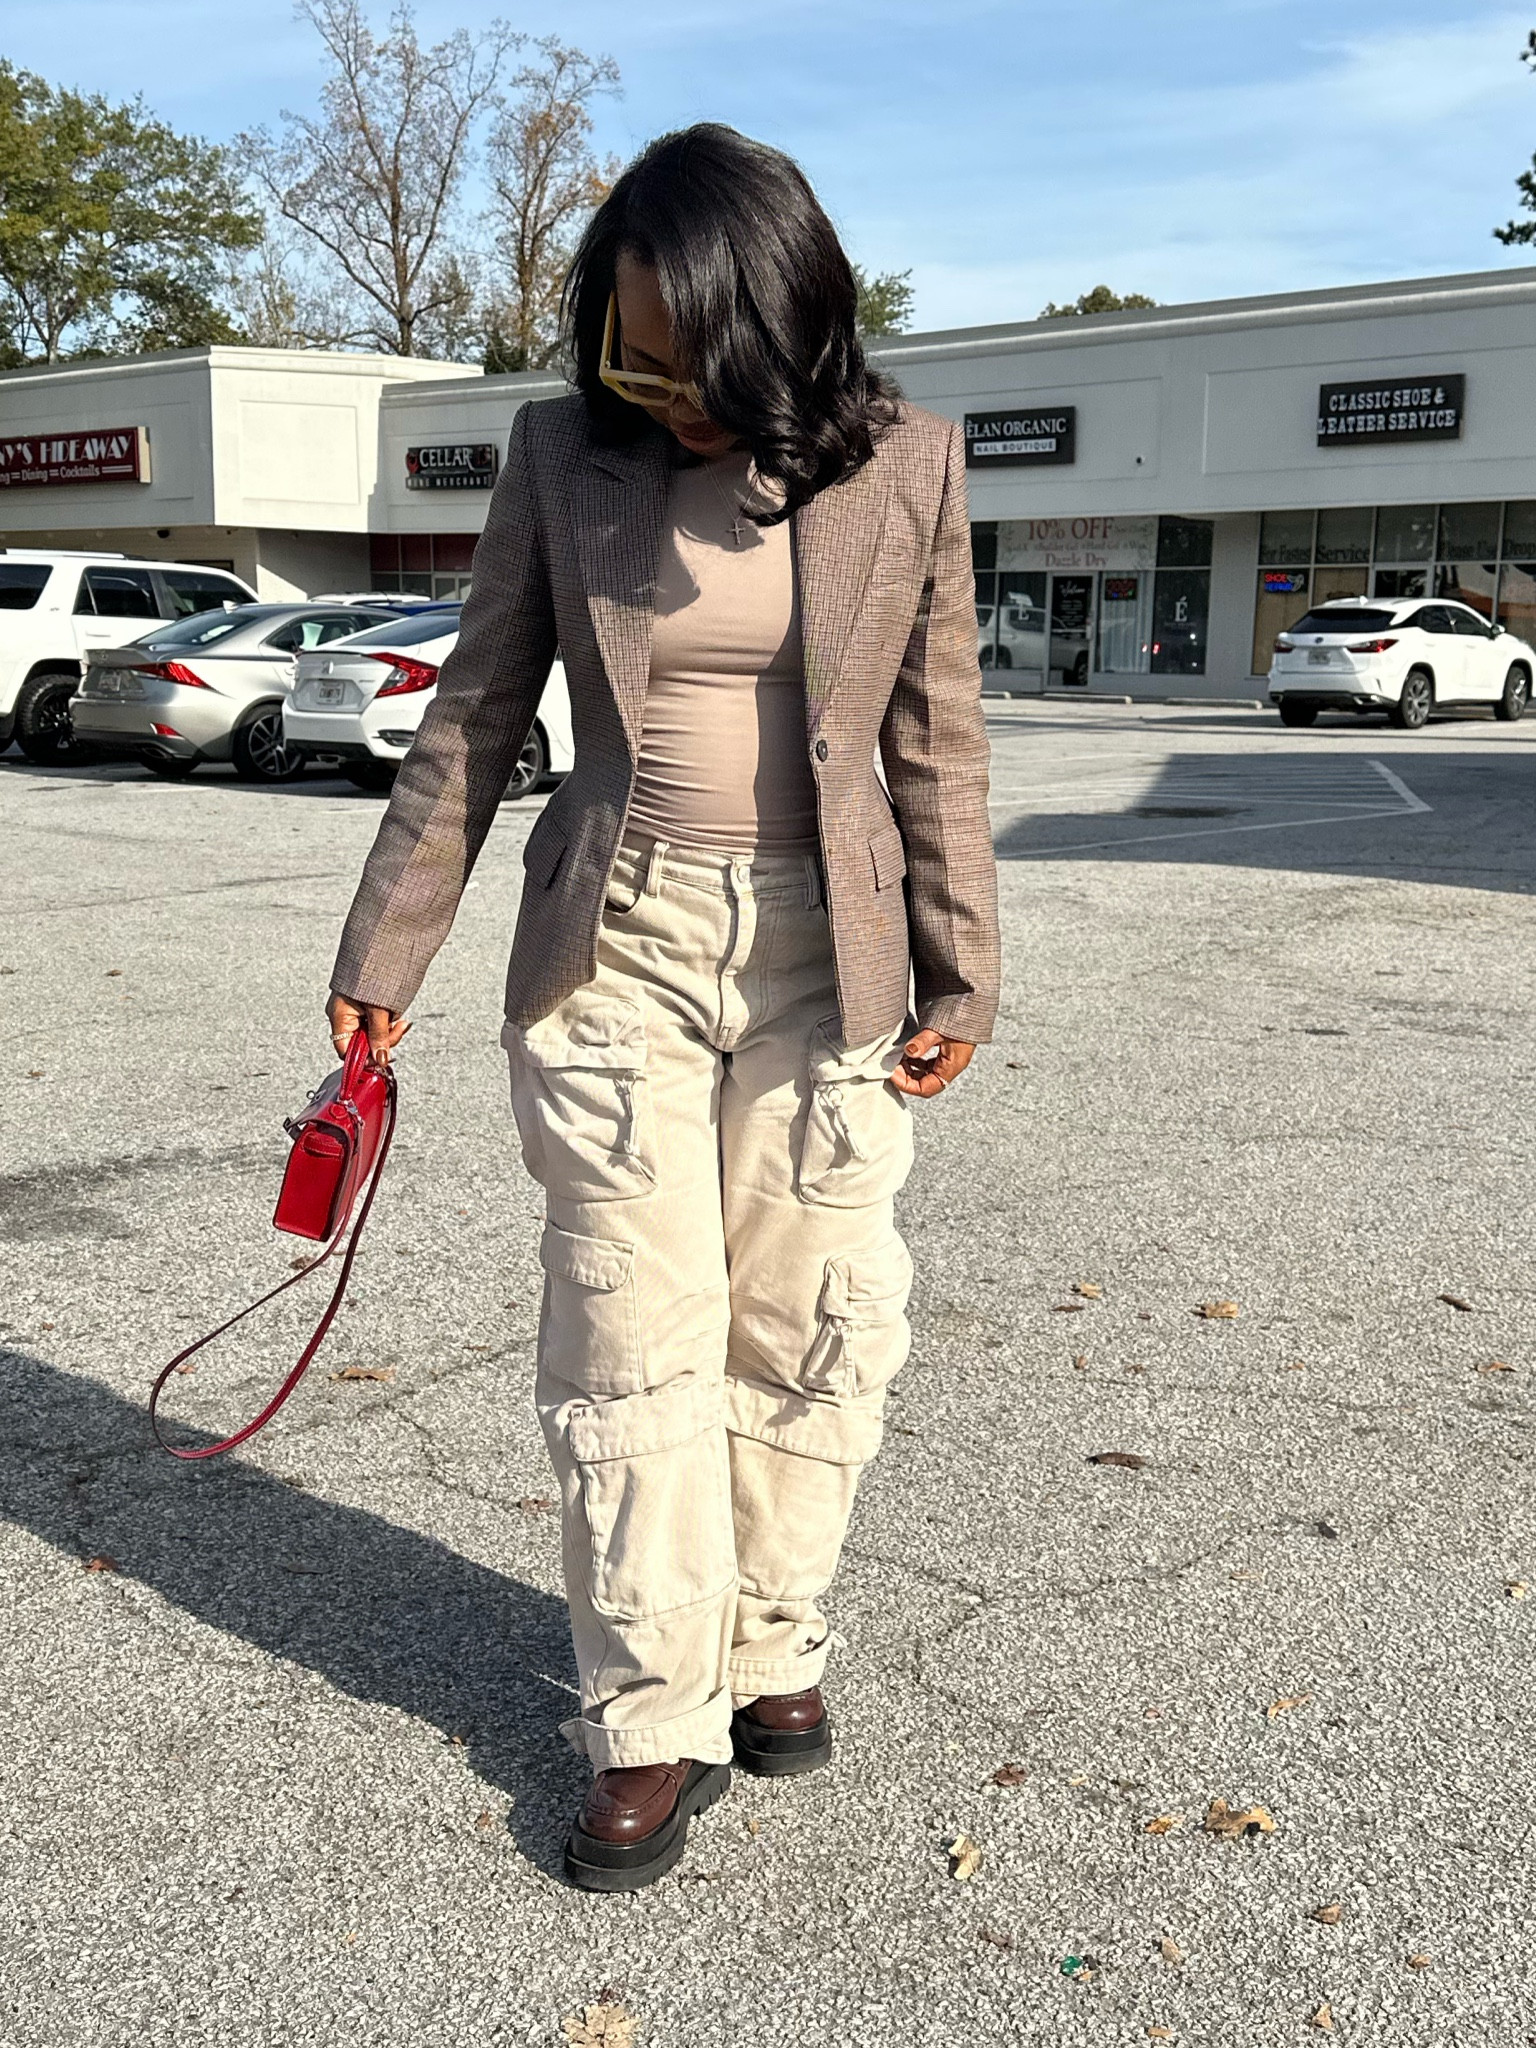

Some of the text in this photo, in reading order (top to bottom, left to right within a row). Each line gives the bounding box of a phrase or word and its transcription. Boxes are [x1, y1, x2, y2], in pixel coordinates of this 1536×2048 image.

[1328, 386, 1446, 411] CLASSIC SHOE &
[1003, 417, 1067, 436] ORGANIC
[1317, 409, 1457, 435] LEATHER SERVICE
[40, 435, 132, 464] HIDEAWAY
[419, 447, 475, 470] CELLAR
[976, 441, 1054, 453] NAIL BOUTIQUE
[21, 467, 48, 483] Dining
[60, 463, 101, 479] Cocktails
[1028, 519, 1066, 540] 10%
[1071, 517, 1114, 540] OFF
[1264, 573, 1288, 583] SHOE
